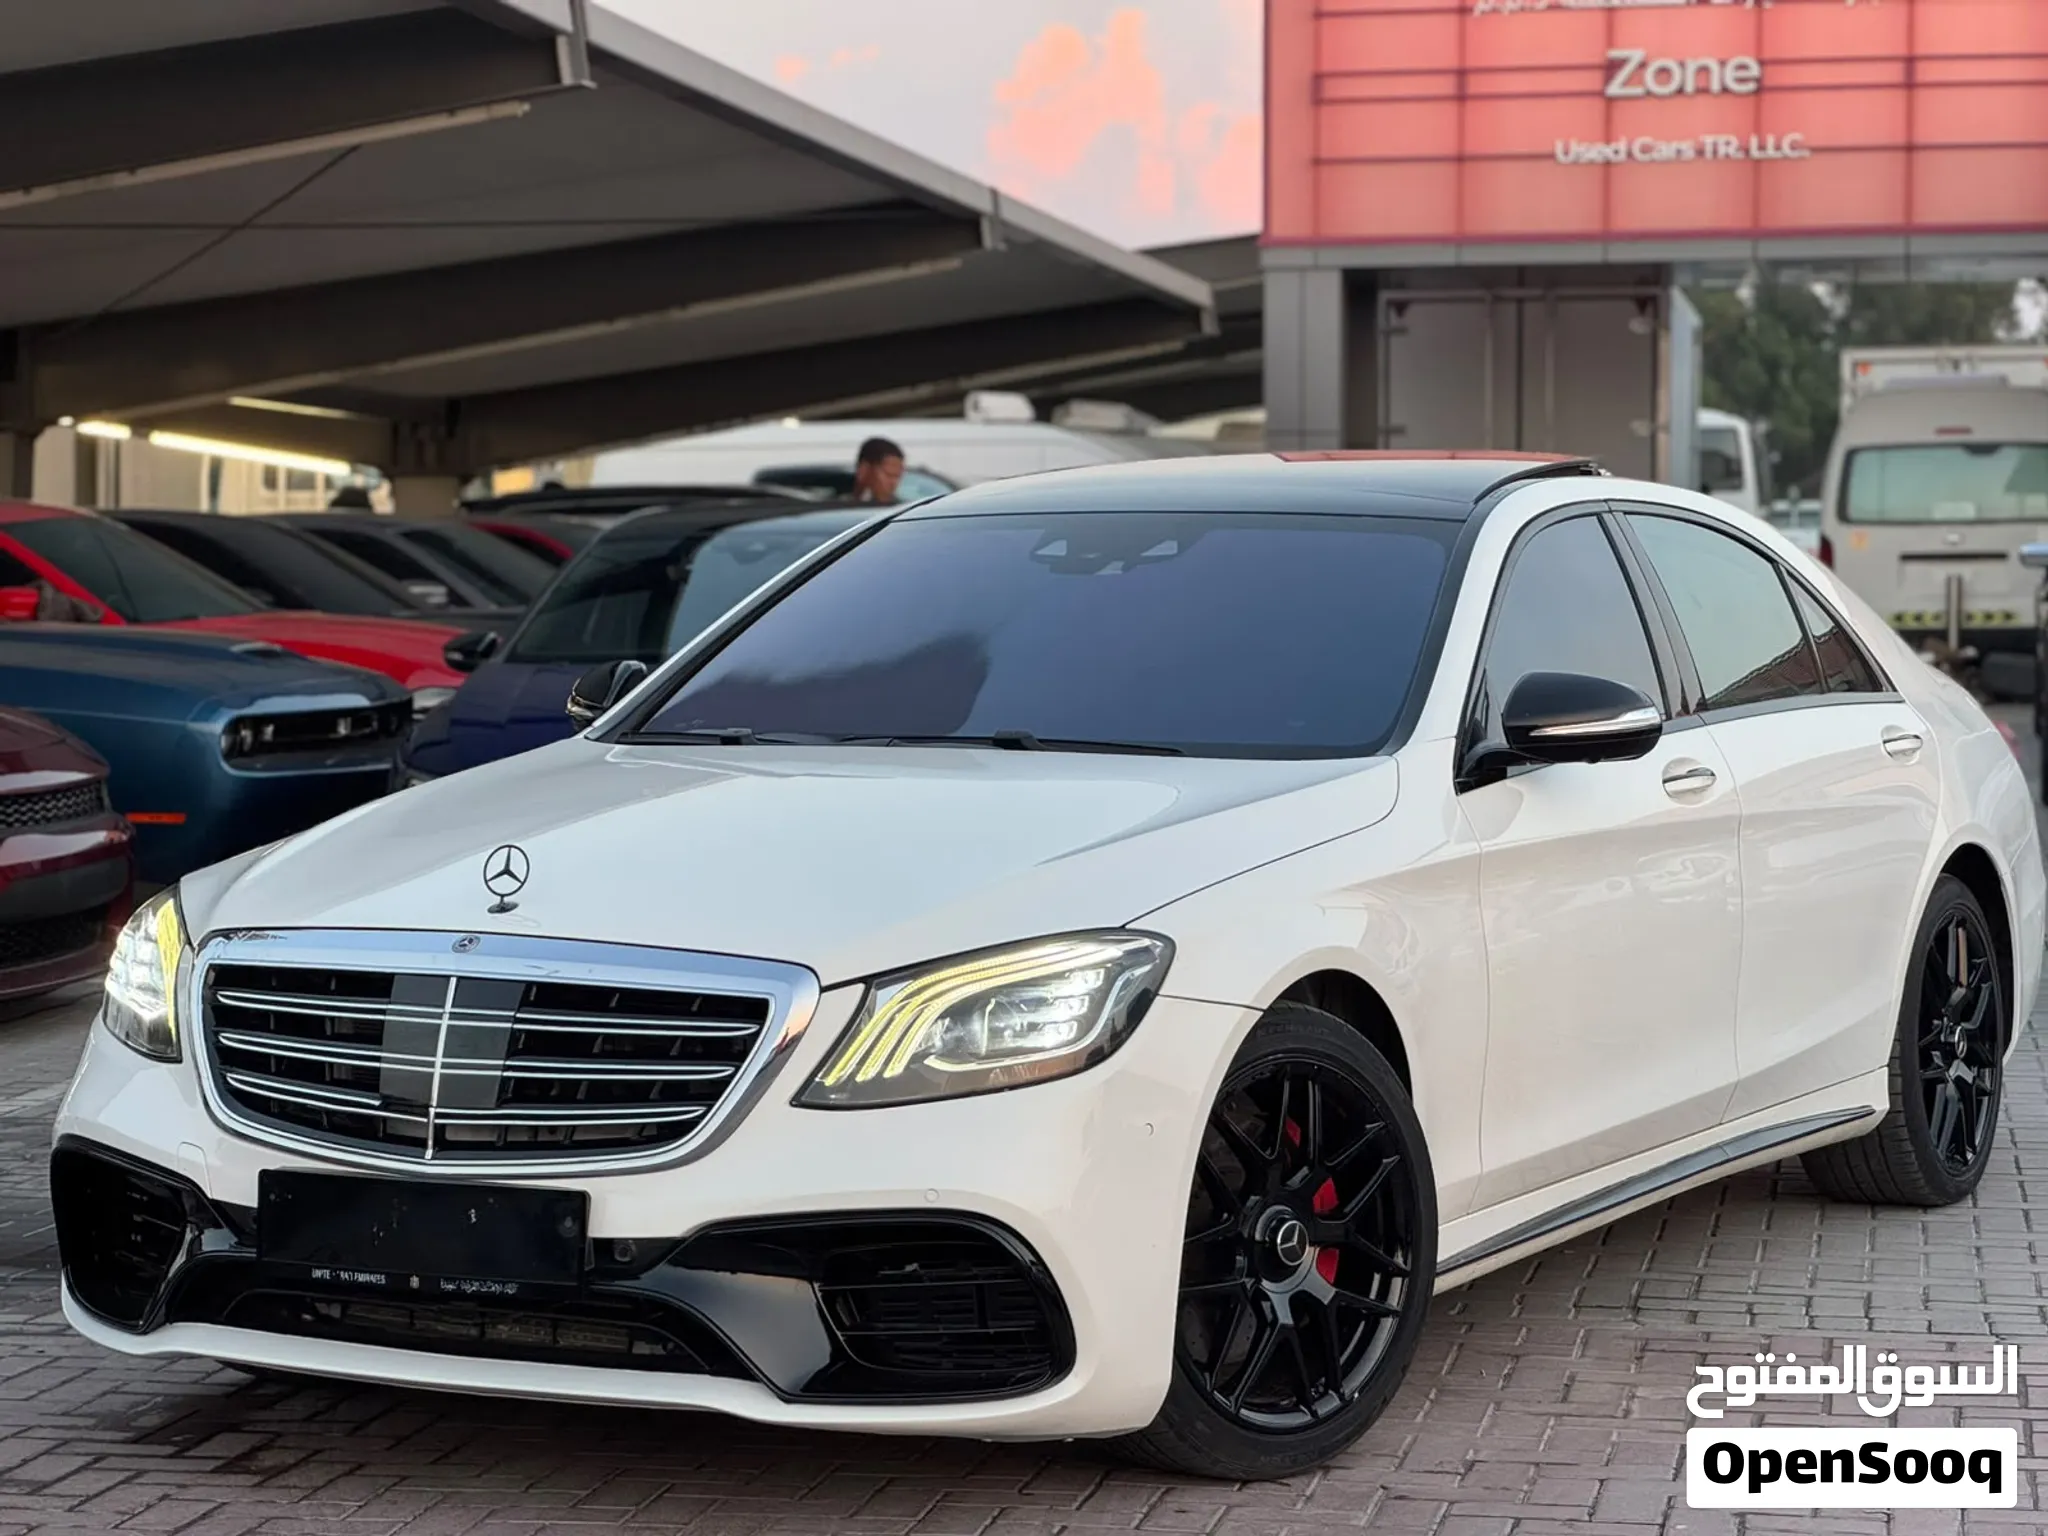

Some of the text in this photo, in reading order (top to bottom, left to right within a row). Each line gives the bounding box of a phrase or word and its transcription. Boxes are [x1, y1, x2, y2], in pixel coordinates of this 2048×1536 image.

[1605, 49, 1761, 96] Zone
[1555, 137, 1627, 164] Used
[1632, 136, 1696, 162] Cars
